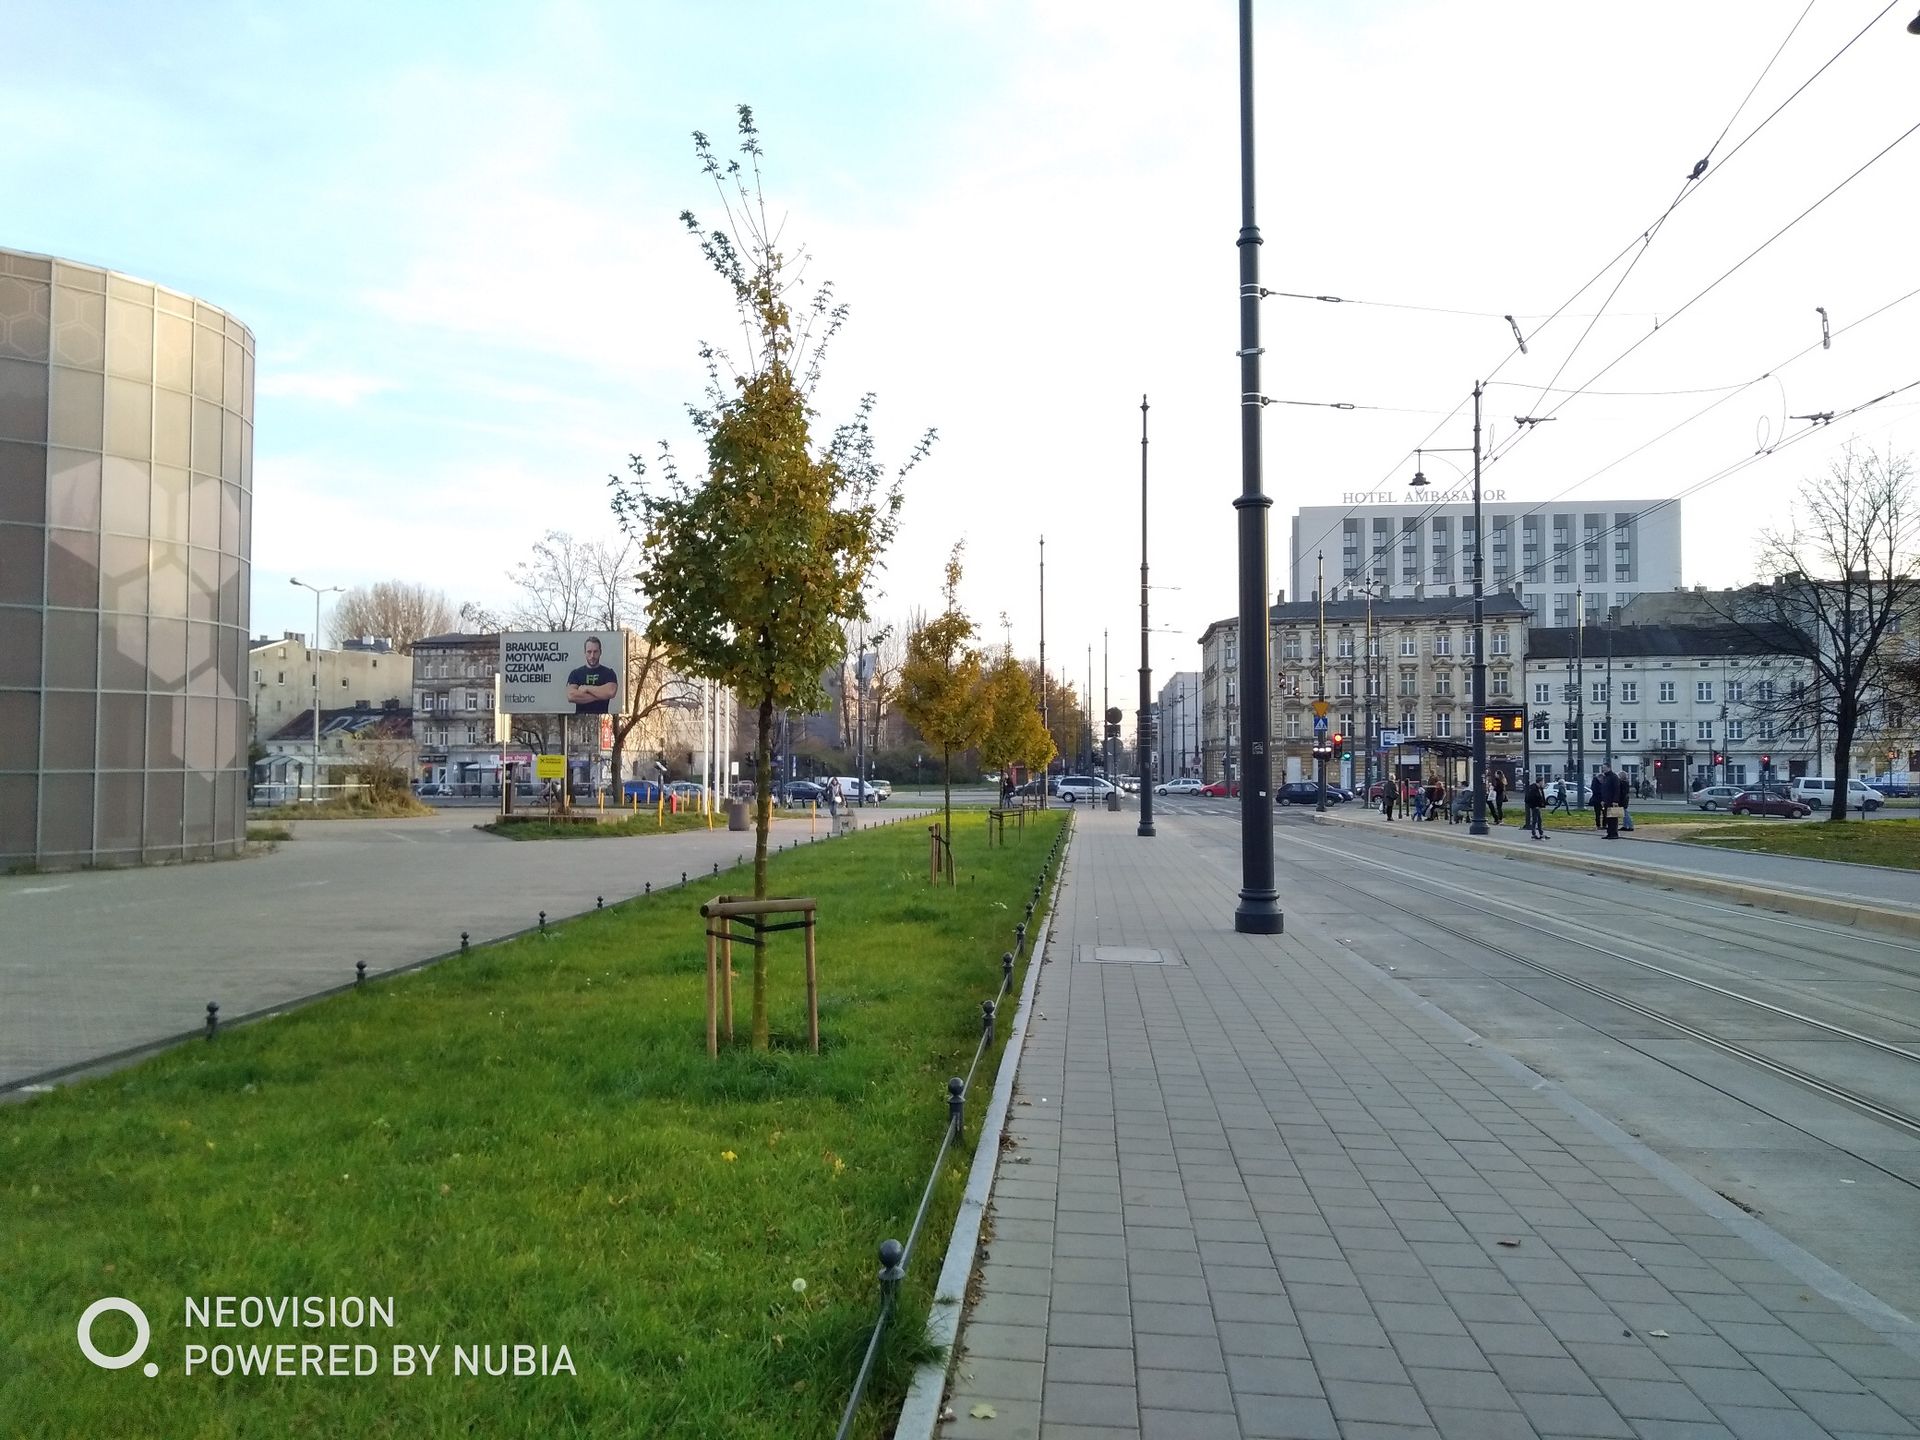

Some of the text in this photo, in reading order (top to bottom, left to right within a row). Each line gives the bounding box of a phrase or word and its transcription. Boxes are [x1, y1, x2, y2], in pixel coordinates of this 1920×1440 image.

[1342, 489, 1506, 504] HOTEL AMBASAOR
[505, 642, 558, 651] BRAKUJE CI
[505, 652, 569, 662] MOTYWACJI?
[505, 663, 544, 672] CZEKAM
[505, 673, 552, 683] NA CIEBIE!
[586, 674, 600, 684] FF
